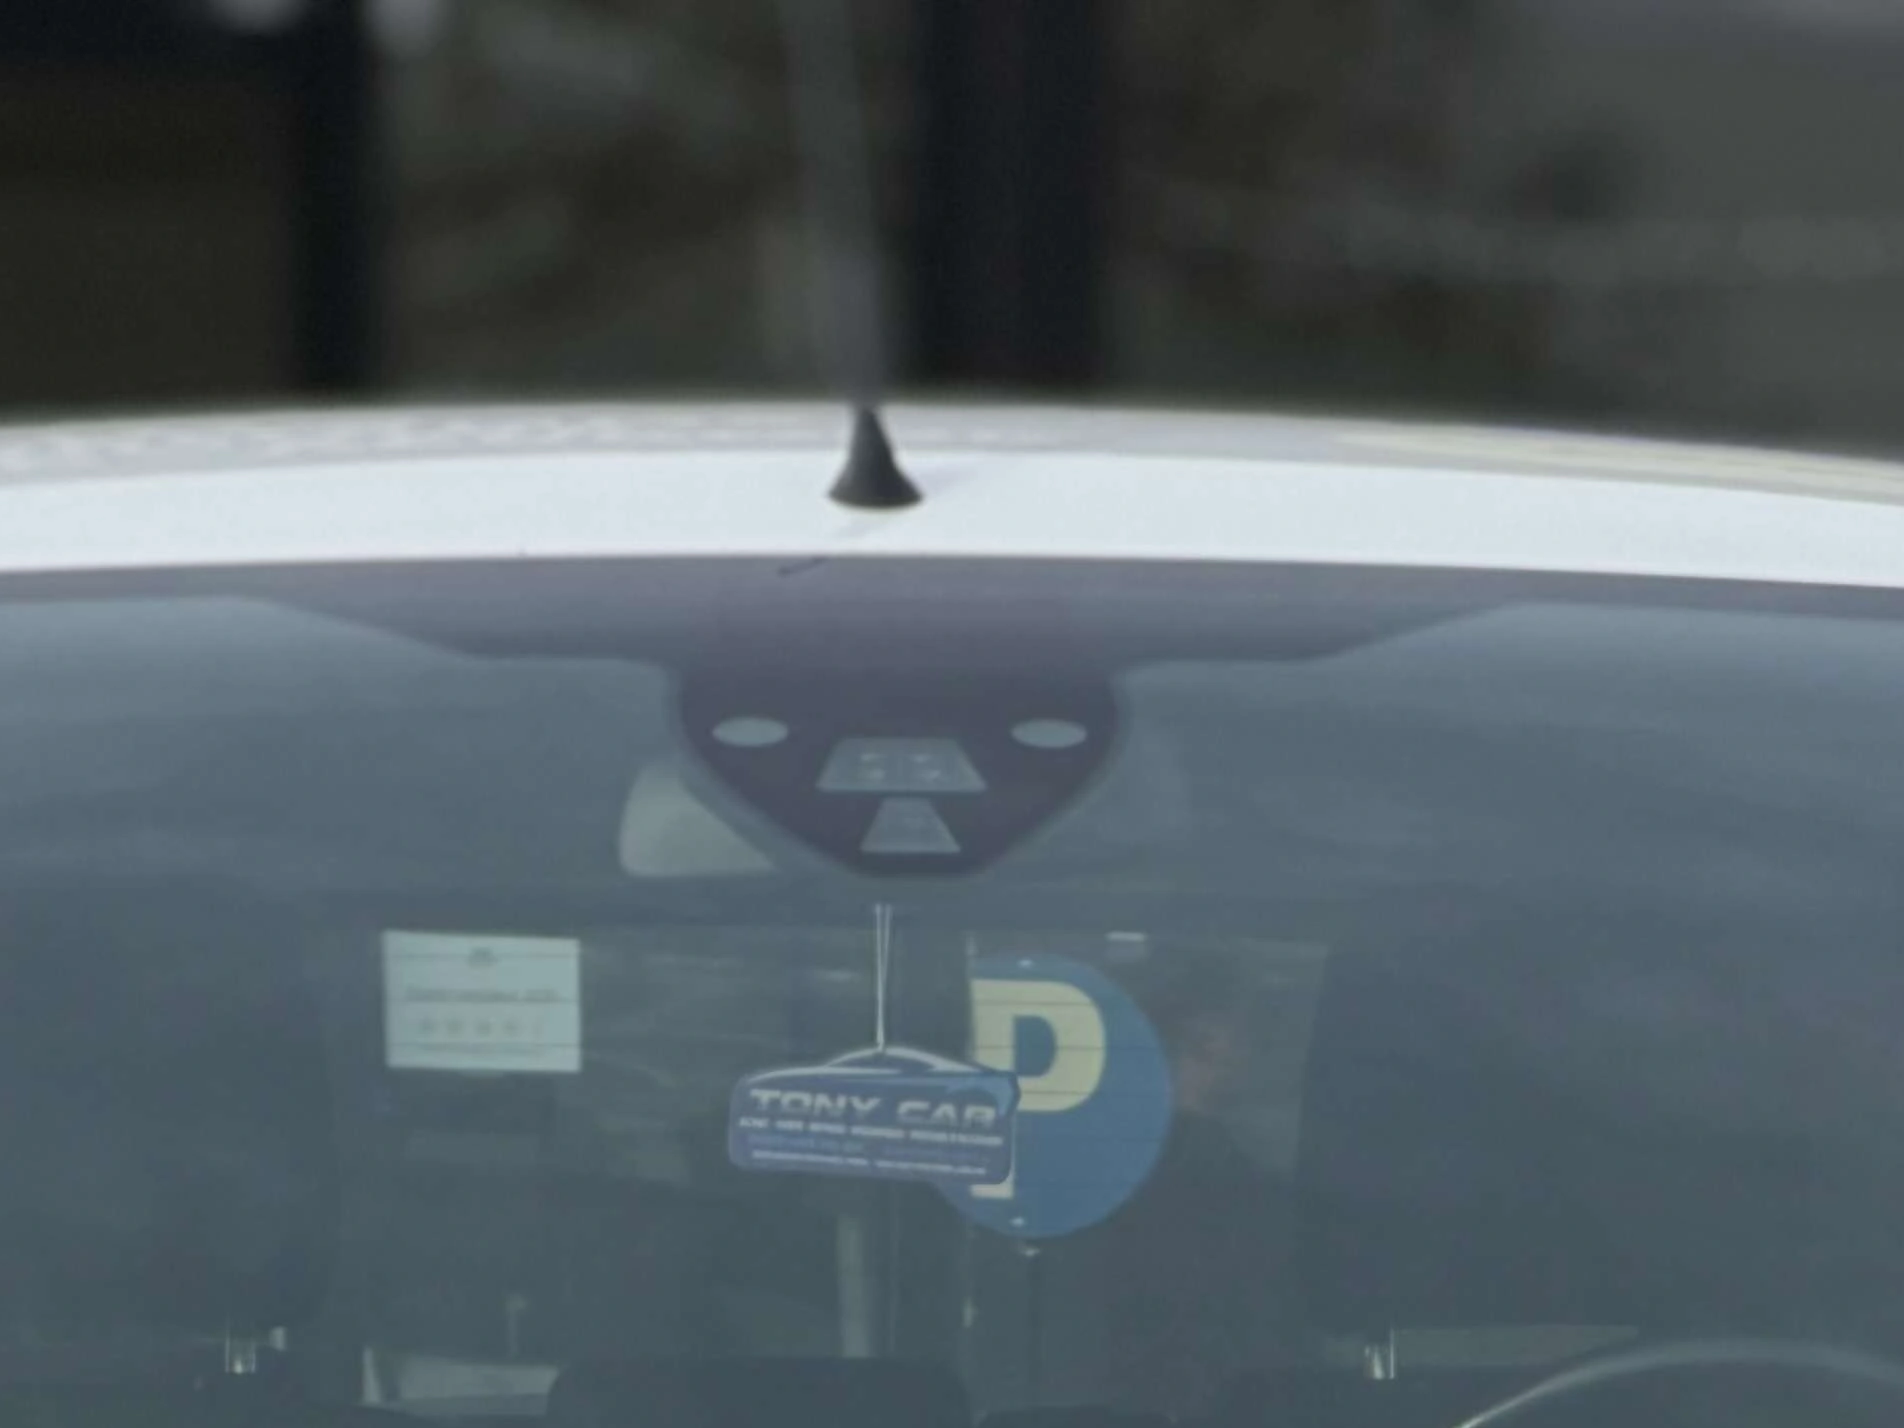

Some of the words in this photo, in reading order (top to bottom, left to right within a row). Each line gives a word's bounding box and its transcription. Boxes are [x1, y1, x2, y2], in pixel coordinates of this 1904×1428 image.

[749, 1087, 883, 1118] TONY
[897, 1098, 996, 1128] CAR
[970, 979, 1106, 1198] P
